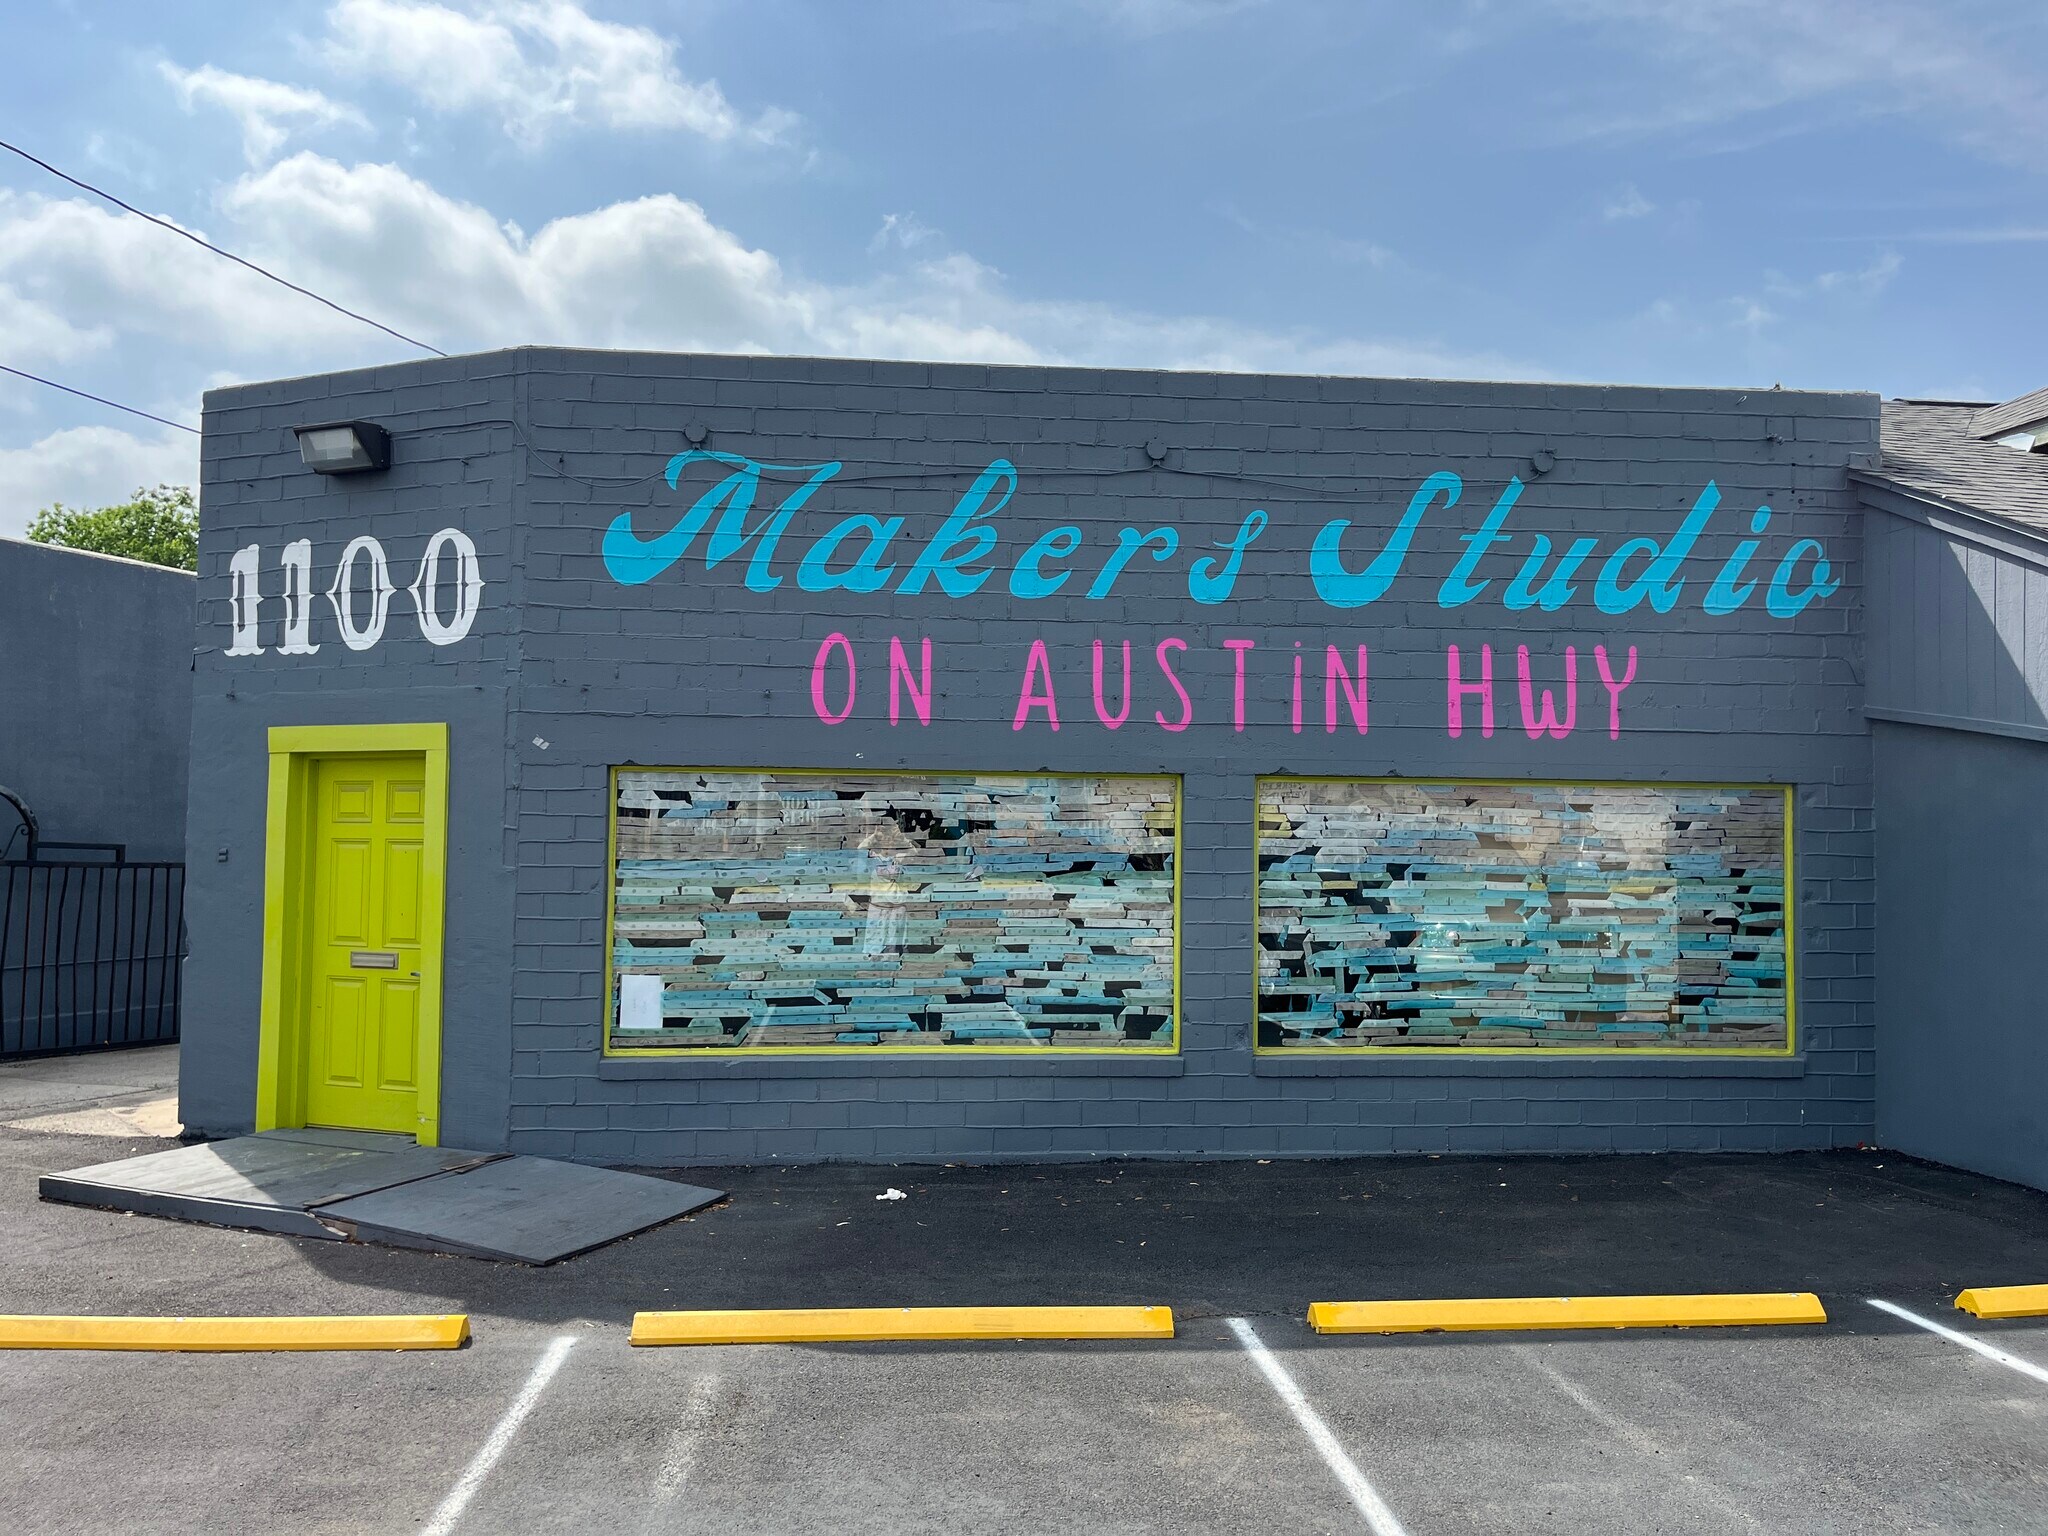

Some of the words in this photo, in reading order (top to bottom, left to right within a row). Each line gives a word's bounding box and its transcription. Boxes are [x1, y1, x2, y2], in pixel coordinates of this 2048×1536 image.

[224, 528, 486, 657] 1100
[601, 450, 1270, 606] Makers
[1309, 470, 1841, 619] Studio
[811, 632, 933, 727] ON
[1447, 643, 1639, 740] HWY
